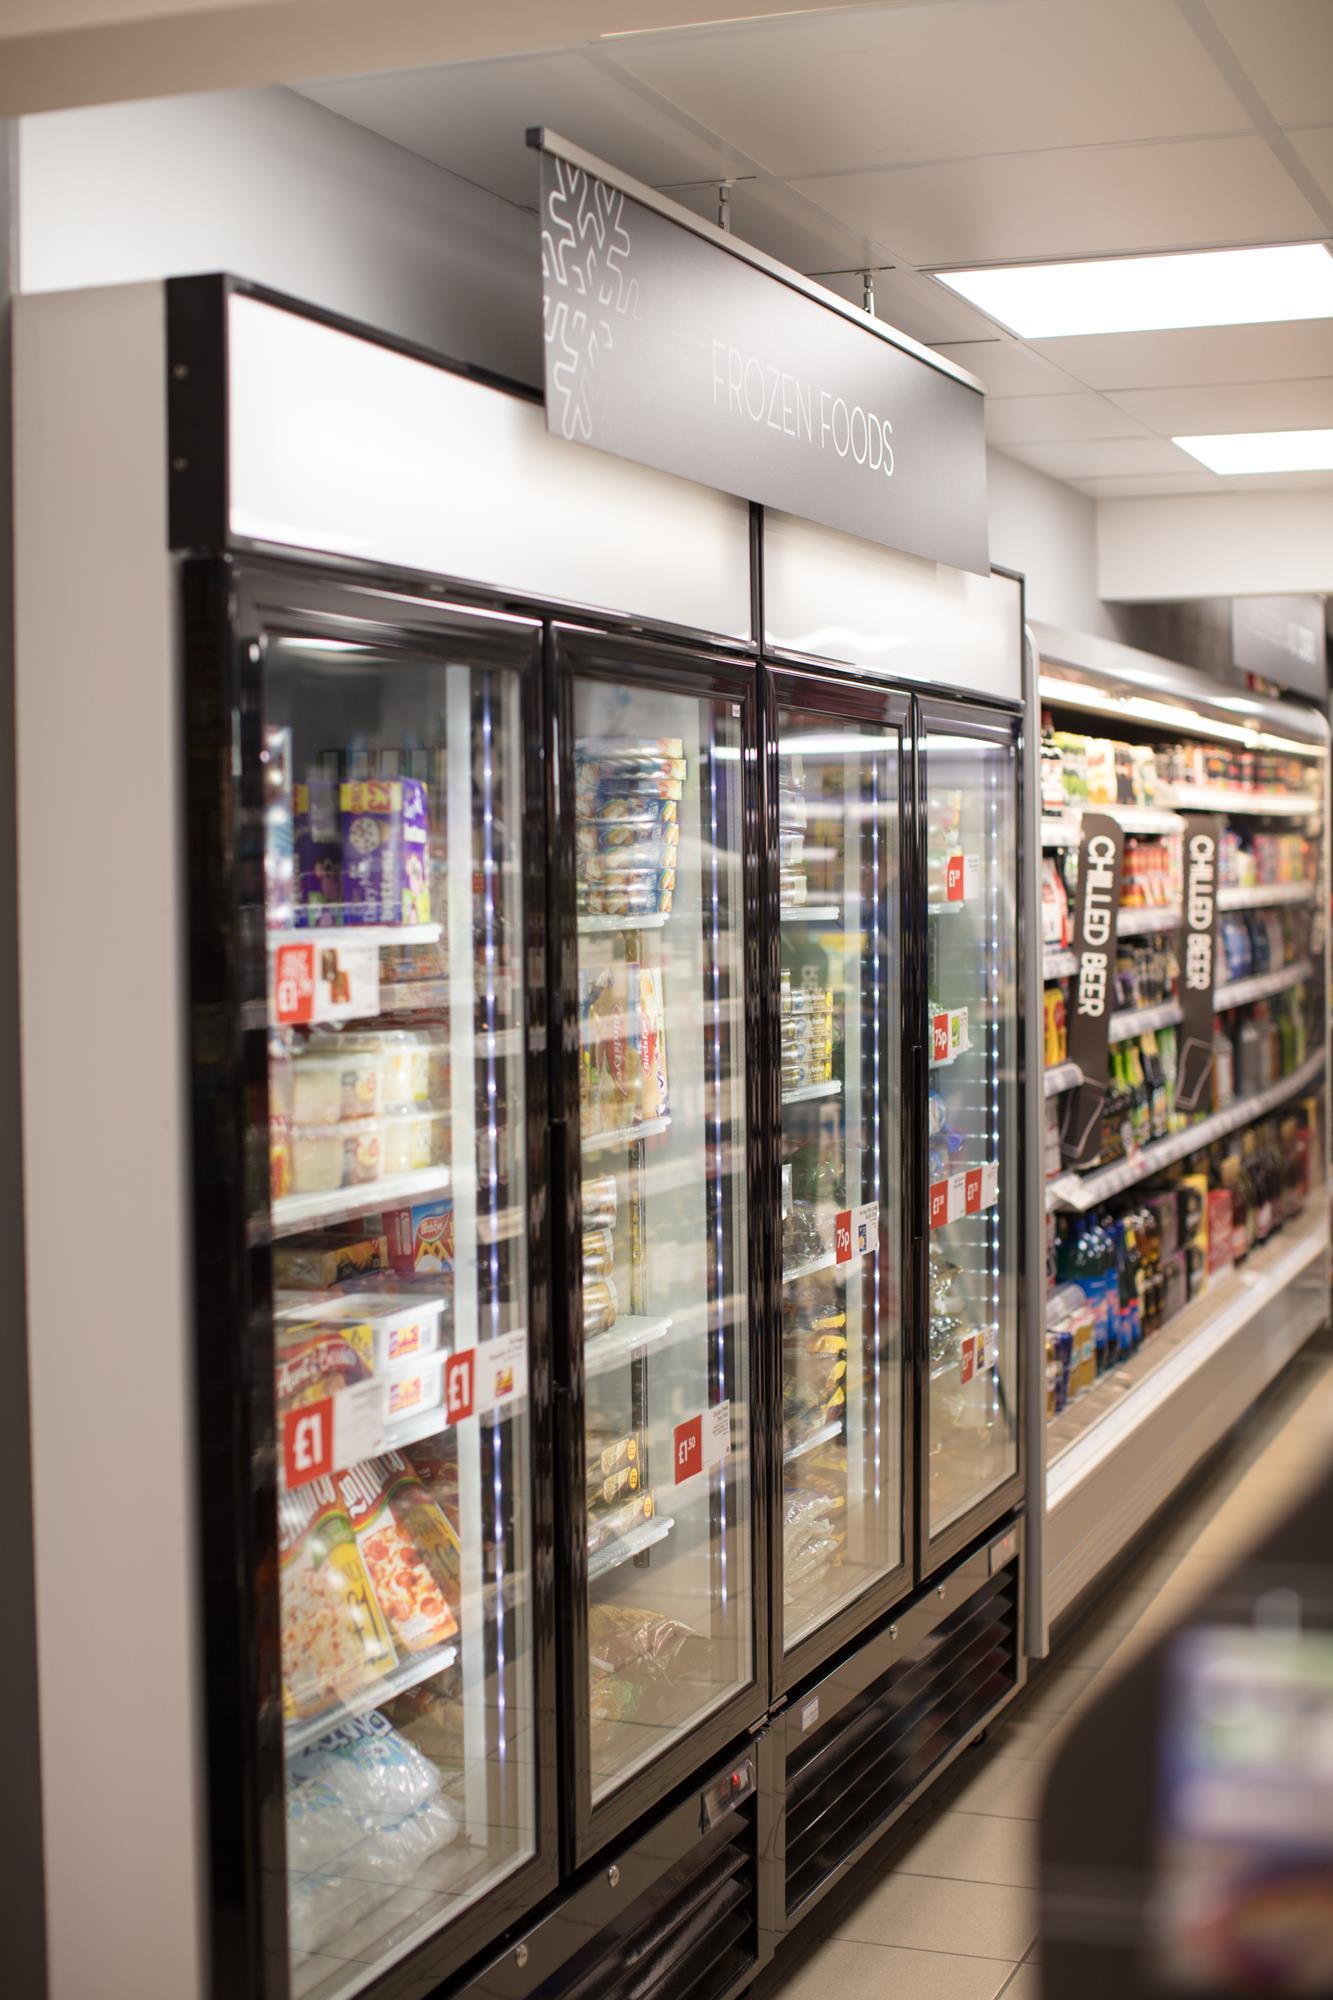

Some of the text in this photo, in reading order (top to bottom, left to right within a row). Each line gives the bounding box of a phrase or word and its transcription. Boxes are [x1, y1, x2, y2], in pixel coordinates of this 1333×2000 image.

[712, 339, 895, 477] FROZEN FOODS
[1078, 835, 1116, 1017] CHILLED BEER
[1186, 834, 1215, 990] CHILLED BEER
[936, 1029, 947, 1051] 75p
[837, 1228, 850, 1253] 75p
[448, 1361, 470, 1413] £1
[293, 1413, 323, 1471] £1
